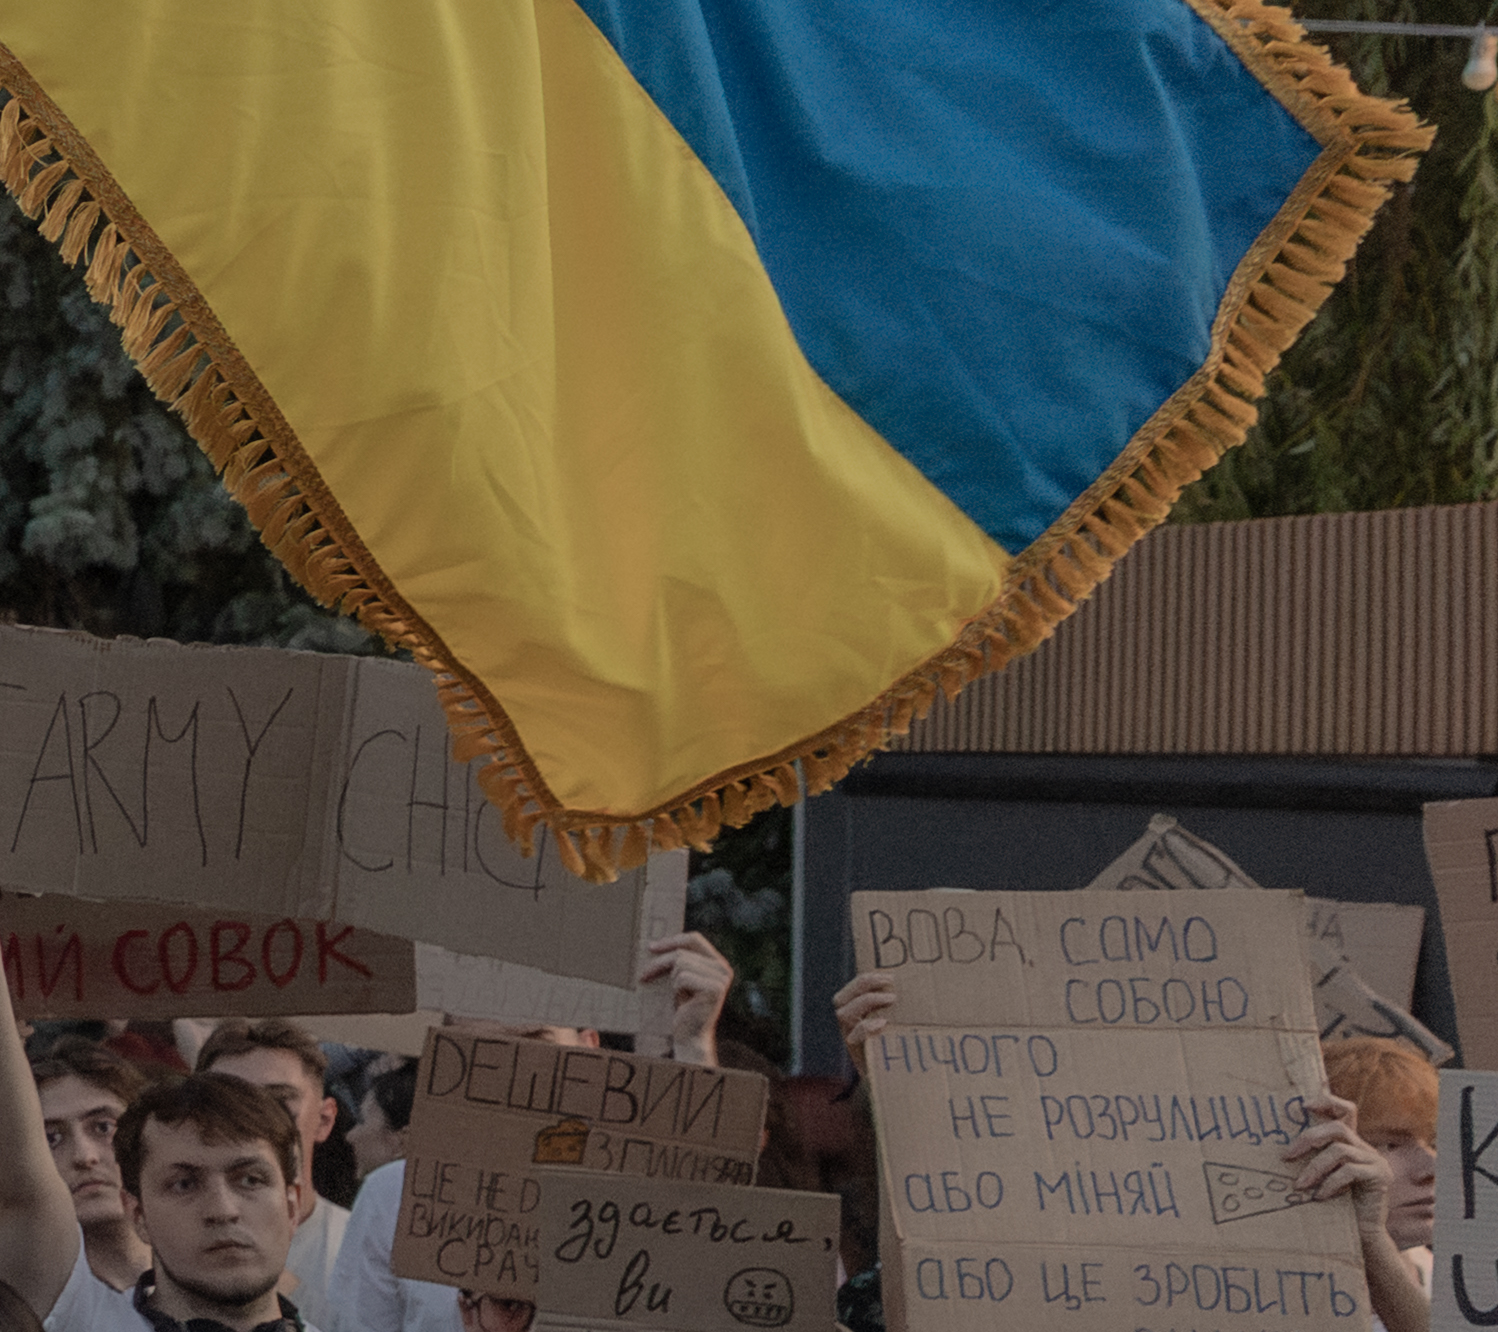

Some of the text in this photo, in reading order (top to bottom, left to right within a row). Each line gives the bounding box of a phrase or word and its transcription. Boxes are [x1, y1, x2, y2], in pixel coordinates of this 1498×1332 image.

[9, 682, 296, 866] ARMY
[111, 919, 375, 997] СОВОК
[1064, 976, 1250, 1025] СОБОЮ
[881, 1028, 1060, 1078] НІЧОГО
[950, 1095, 1016, 1140] НЕ
[1035, 1161, 1183, 1220] МІНЯЙ
[408, 1202, 541, 1250] ВИКИДАН
[552, 1198, 836, 1263] здається,
[615, 1249, 673, 1318] ви
[1041, 1261, 1108, 1312] ЦЕ
[1133, 1263, 1358, 1318] ЗРОБИТЬ
